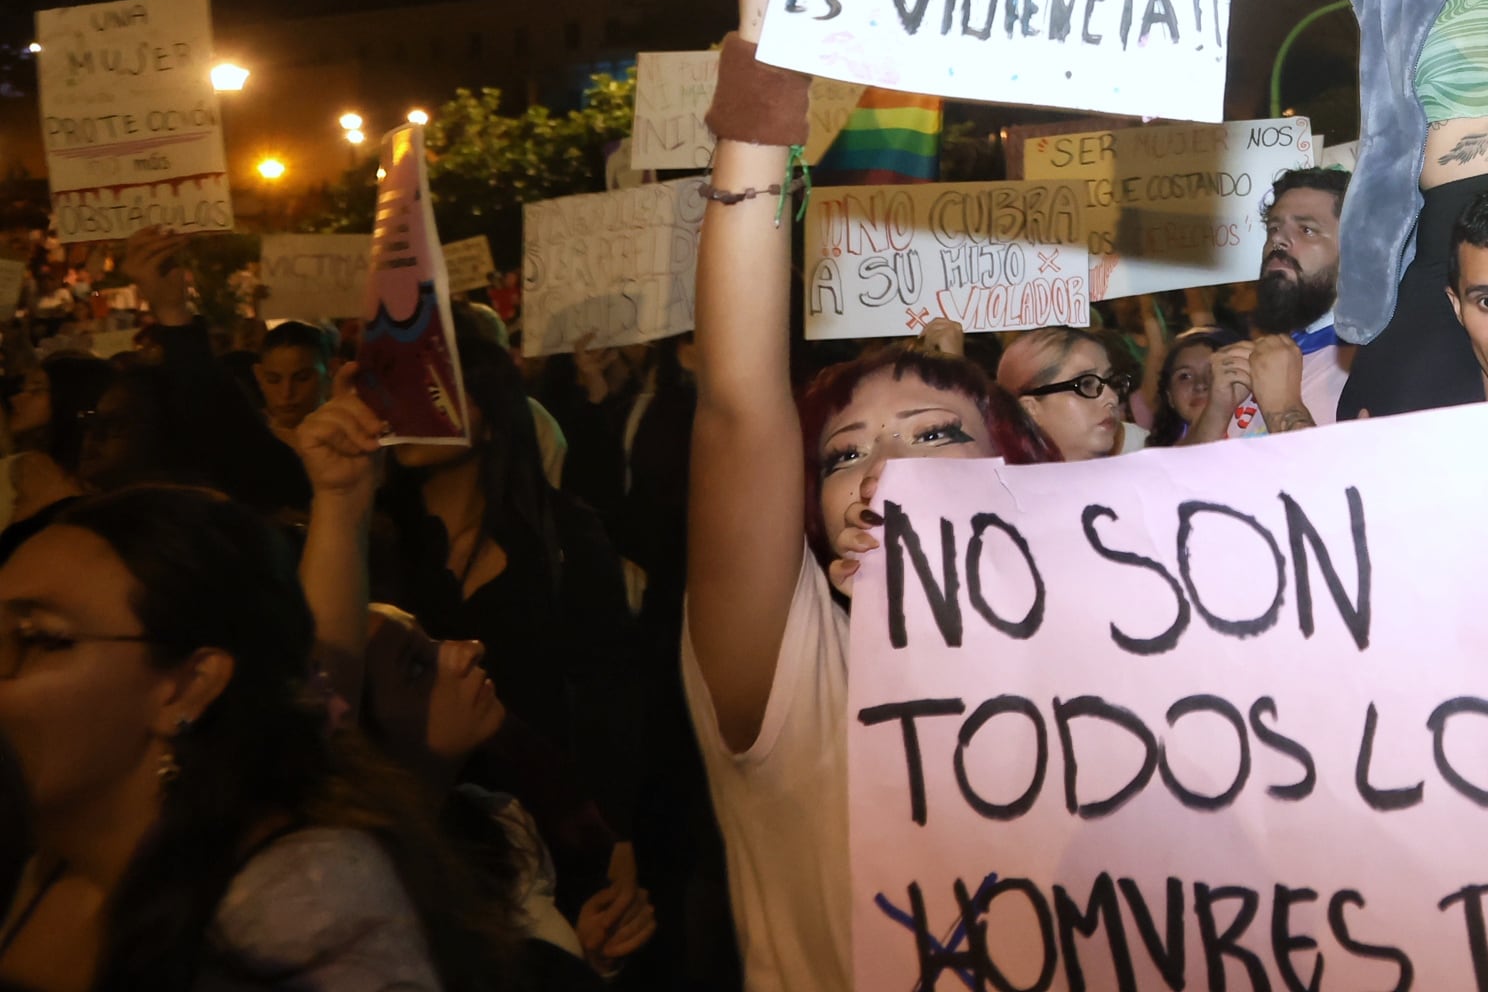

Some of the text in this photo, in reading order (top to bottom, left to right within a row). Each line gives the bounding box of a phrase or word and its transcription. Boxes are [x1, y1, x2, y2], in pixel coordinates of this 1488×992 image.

[89, 4, 148, 32] UNA
[1133, 125, 1230, 158] MUJER
[1246, 125, 1293, 150] NOS
[929, 185, 1080, 249] CUBRA
[1086, 171, 1252, 208] IGUE COSTANDO
[810, 242, 1026, 317] A SU HIJO
[936, 275, 1088, 331] VIOLADOR
[884, 486, 1372, 655] NO SON
[858, 693, 1317, 826] TODOS
